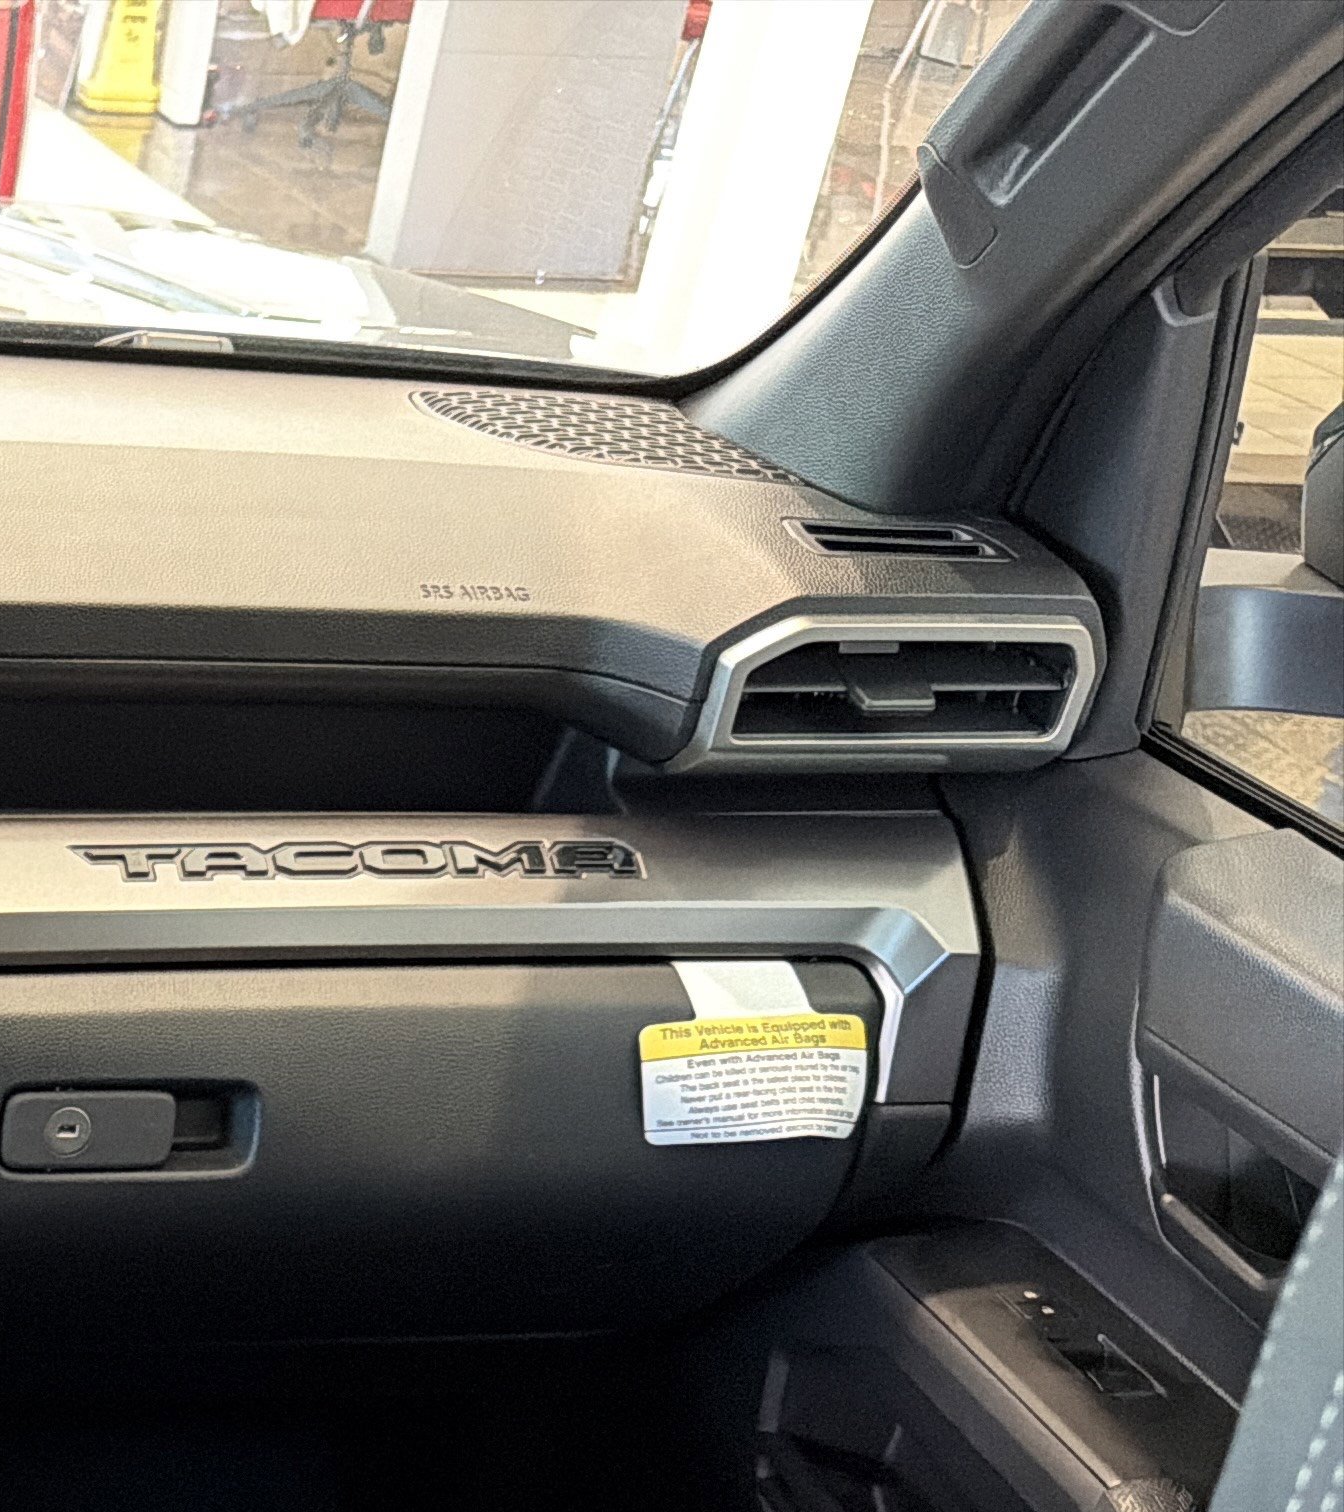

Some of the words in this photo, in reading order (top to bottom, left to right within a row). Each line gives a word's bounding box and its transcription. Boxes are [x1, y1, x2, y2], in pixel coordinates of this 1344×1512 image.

[420, 584, 454, 599] SRS
[459, 584, 531, 602] AIRBAG
[66, 839, 648, 883] TACOMA
[659, 1027, 692, 1040] This
[695, 1024, 744, 1036] Vehicle
[761, 1019, 826, 1035] Equipped
[829, 1019, 851, 1030] with
[699, 1036, 768, 1050] Advanced
[772, 1035, 789, 1044] Air
[793, 1032, 827, 1046] Bags
[686, 1058, 716, 1069] Even
[719, 1055, 743, 1065] with
[746, 1052, 798, 1062] Advanced
[801, 1051, 814, 1059] Air
[817, 1050, 840, 1061] Bags
[655, 1073, 692, 1084] Children
[694, 1072, 710, 1080] can
[724, 1067, 747, 1075] killed
[679, 1083, 697, 1092] The
[699, 1081, 719, 1091] back
[722, 1080, 740, 1088] seat
[680, 1095, 706, 1104] Never
[708, 1092, 723, 1102] put
[688, 1105, 720, 1114] Always
[712, 1113, 745, 1122] manual
[690, 1131, 709, 1139] Not
